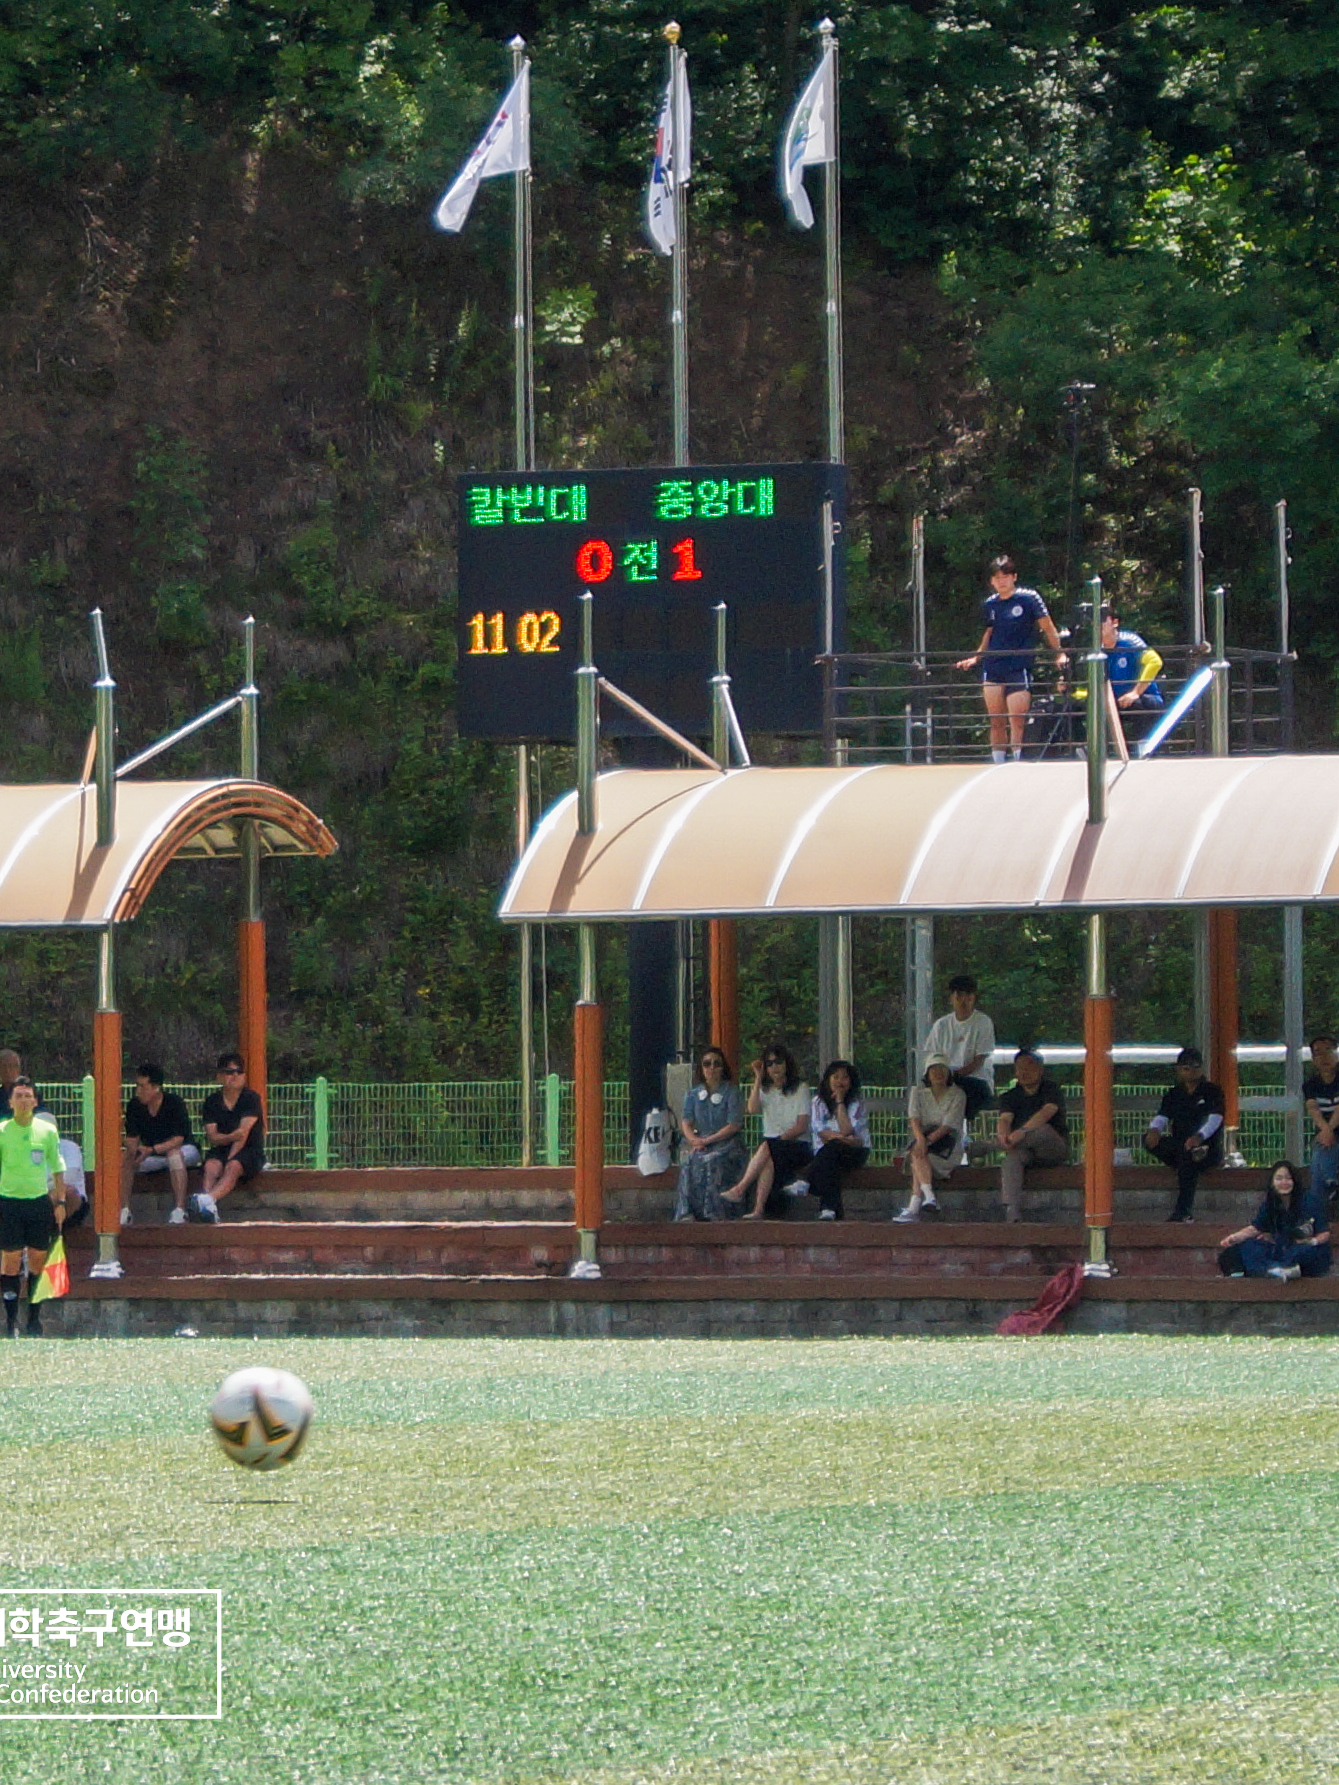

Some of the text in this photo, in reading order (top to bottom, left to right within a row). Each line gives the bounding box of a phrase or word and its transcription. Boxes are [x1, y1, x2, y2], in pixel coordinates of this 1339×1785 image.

[655, 476, 775, 520] 중앙대
[575, 537, 703, 583] 0 전 1
